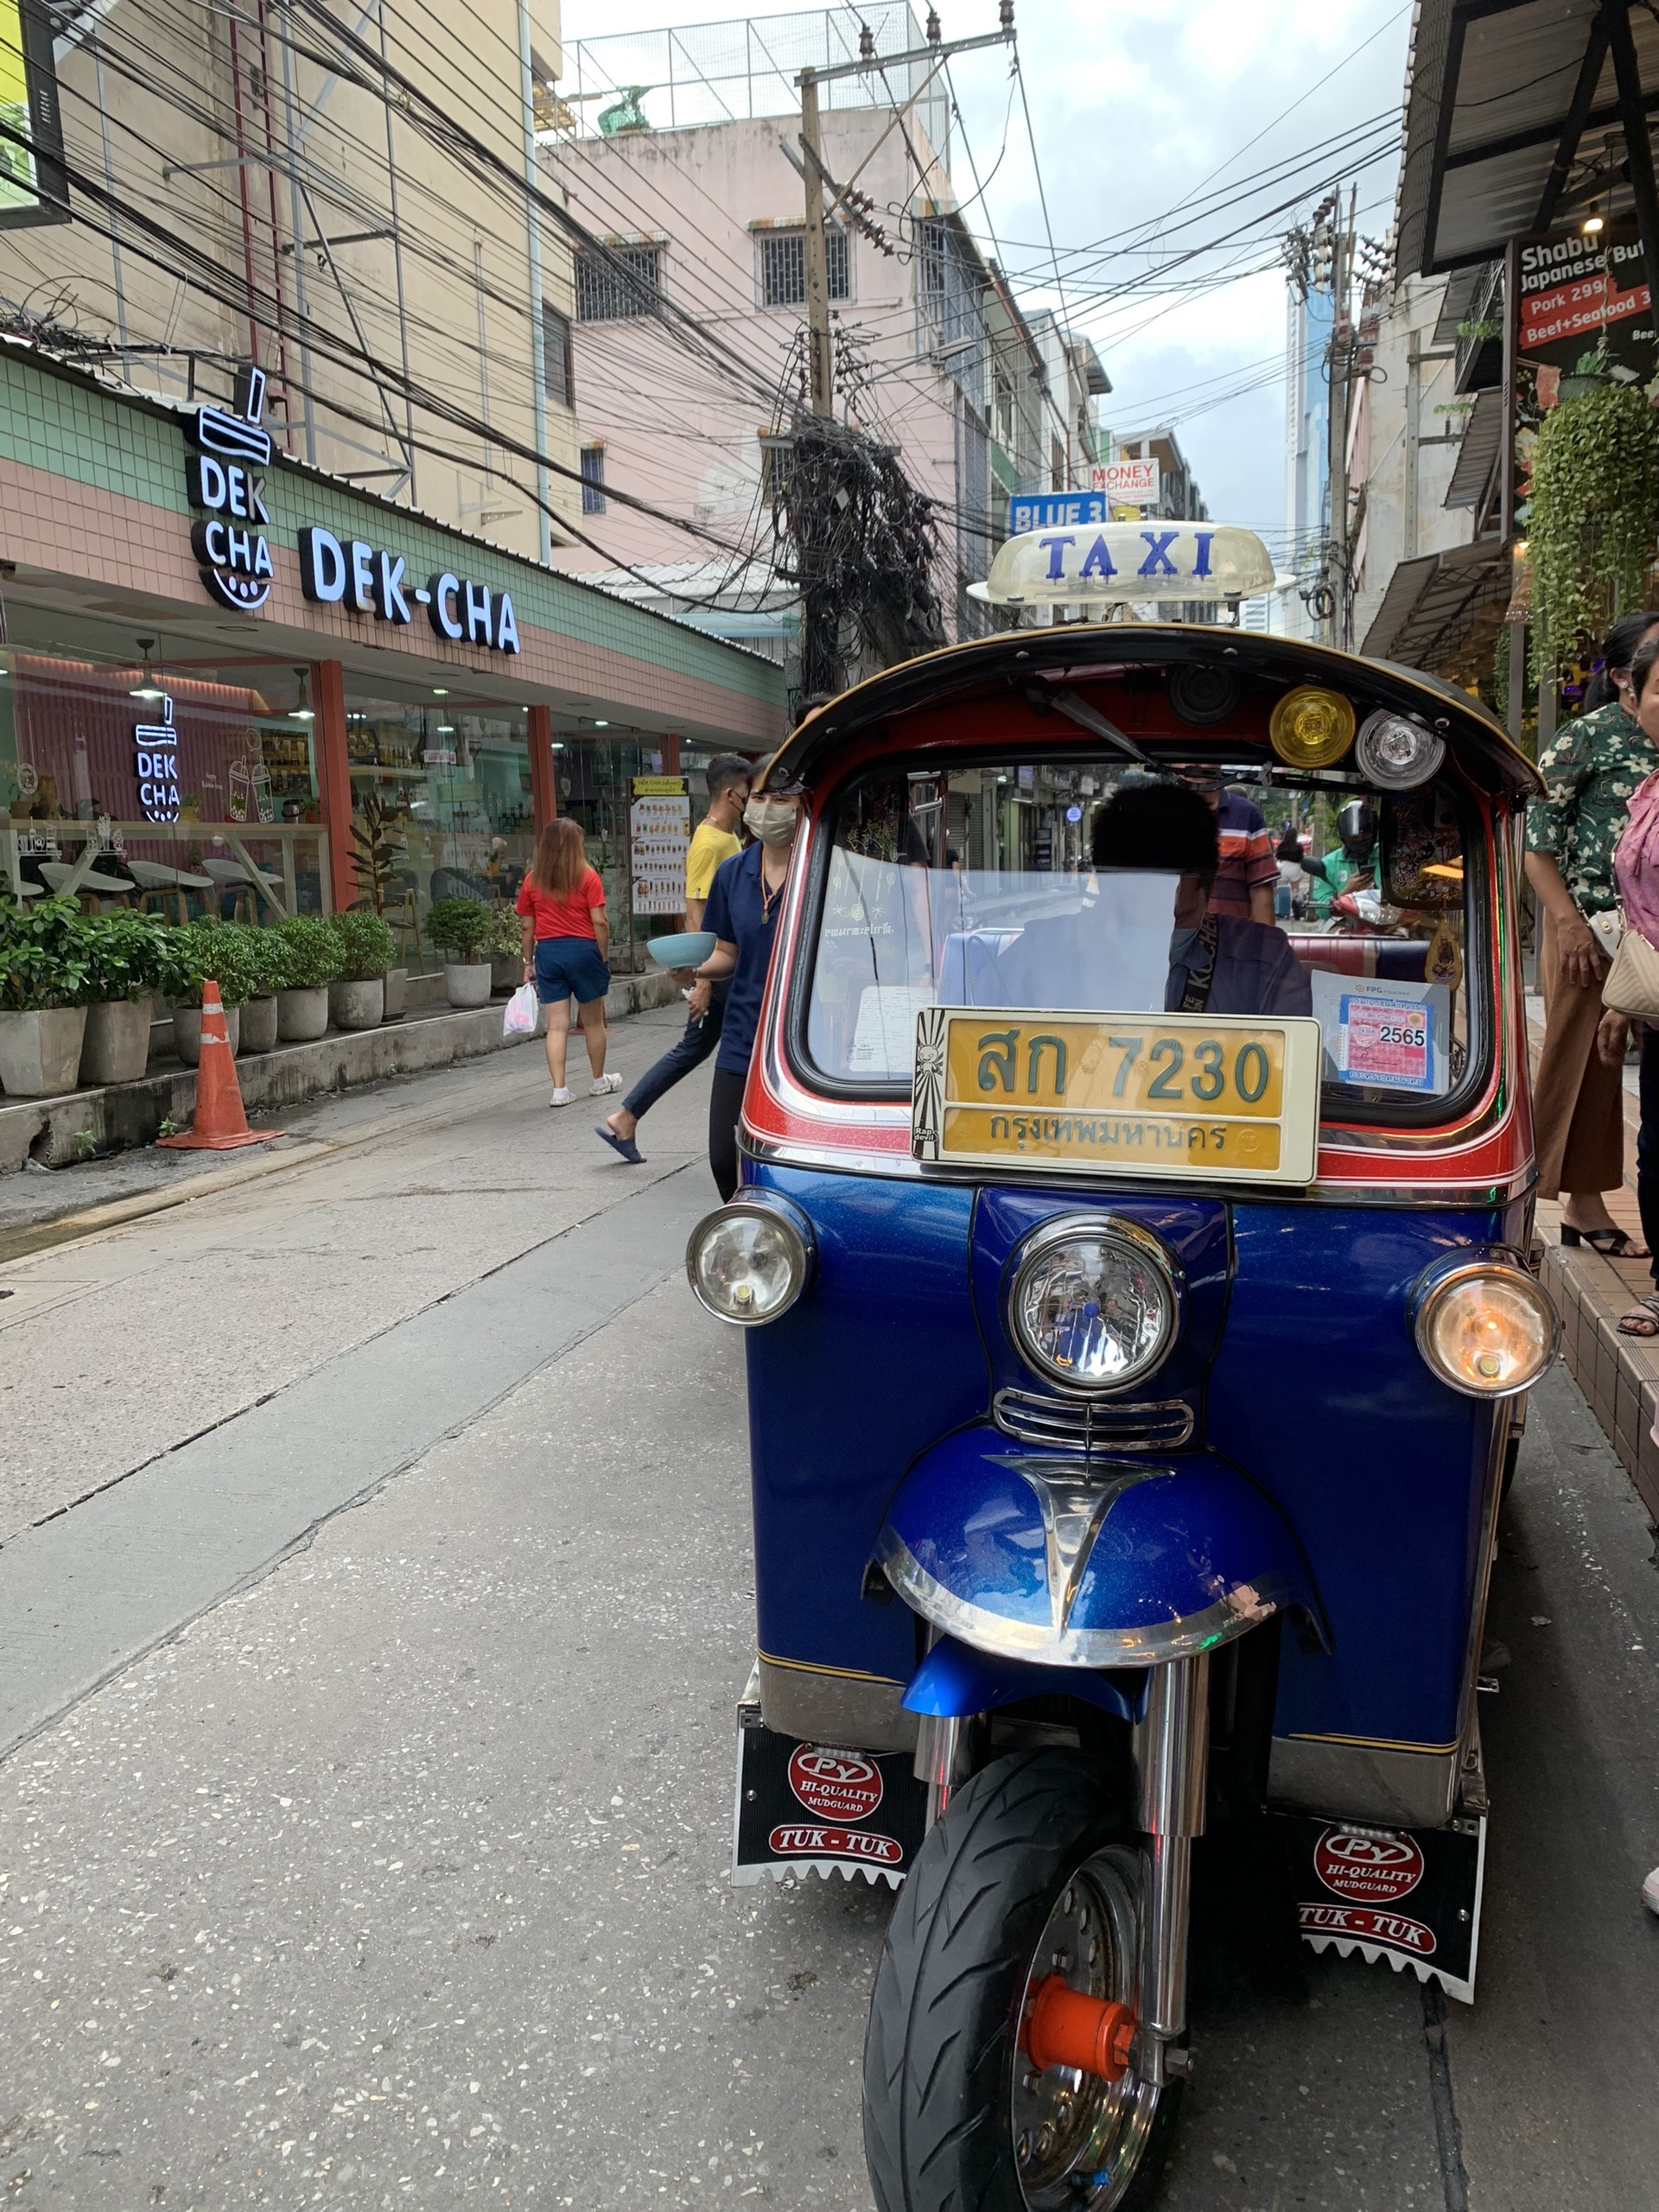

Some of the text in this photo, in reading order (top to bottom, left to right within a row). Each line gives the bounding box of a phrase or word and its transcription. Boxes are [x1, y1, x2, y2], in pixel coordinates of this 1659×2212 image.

[1521, 234, 1599, 271] Shabu
[1521, 254, 1605, 293] Japanese
[1531, 279, 1605, 315] Pork 299
[1527, 296, 1636, 342] Beef+Seafood
[1092, 464, 1154, 481] MONEY
[1092, 477, 1154, 491] EXCHANGE
[200, 455, 270, 525] DEK
[1015, 502, 1081, 532] BLUE
[205, 520, 274, 578] CHA
[1038, 531, 1215, 579] TAXI
[311, 526, 520, 655] DEK-CHA
[137, 752, 178, 779] DEK
[141, 785, 181, 806] CHA
[1366, 985, 1382, 994] FPG
[1380, 1026, 1425, 1046] 2565
[977, 1027, 1066, 1096] สก
[1108, 1036, 1269, 1103] 7230
[915, 1127, 932, 1136] Rap
[990, 1113, 1228, 1151] กรุงเทพมหานคร
[813, 1757, 861, 1782] PY
[800, 1780, 878, 1802] HI-QUALITY
[807, 1796, 864, 1813] MUDGUARD
[779, 1829, 828, 1848] TUK
[846, 1834, 893, 1858] TUK
[1343, 1838, 1398, 1862] PY
[1325, 1864, 1416, 1883] HI-QUALITY
[1332, 1879, 1397, 1893] MUDGUARD
[1371, 1915, 1427, 1946] TUK
